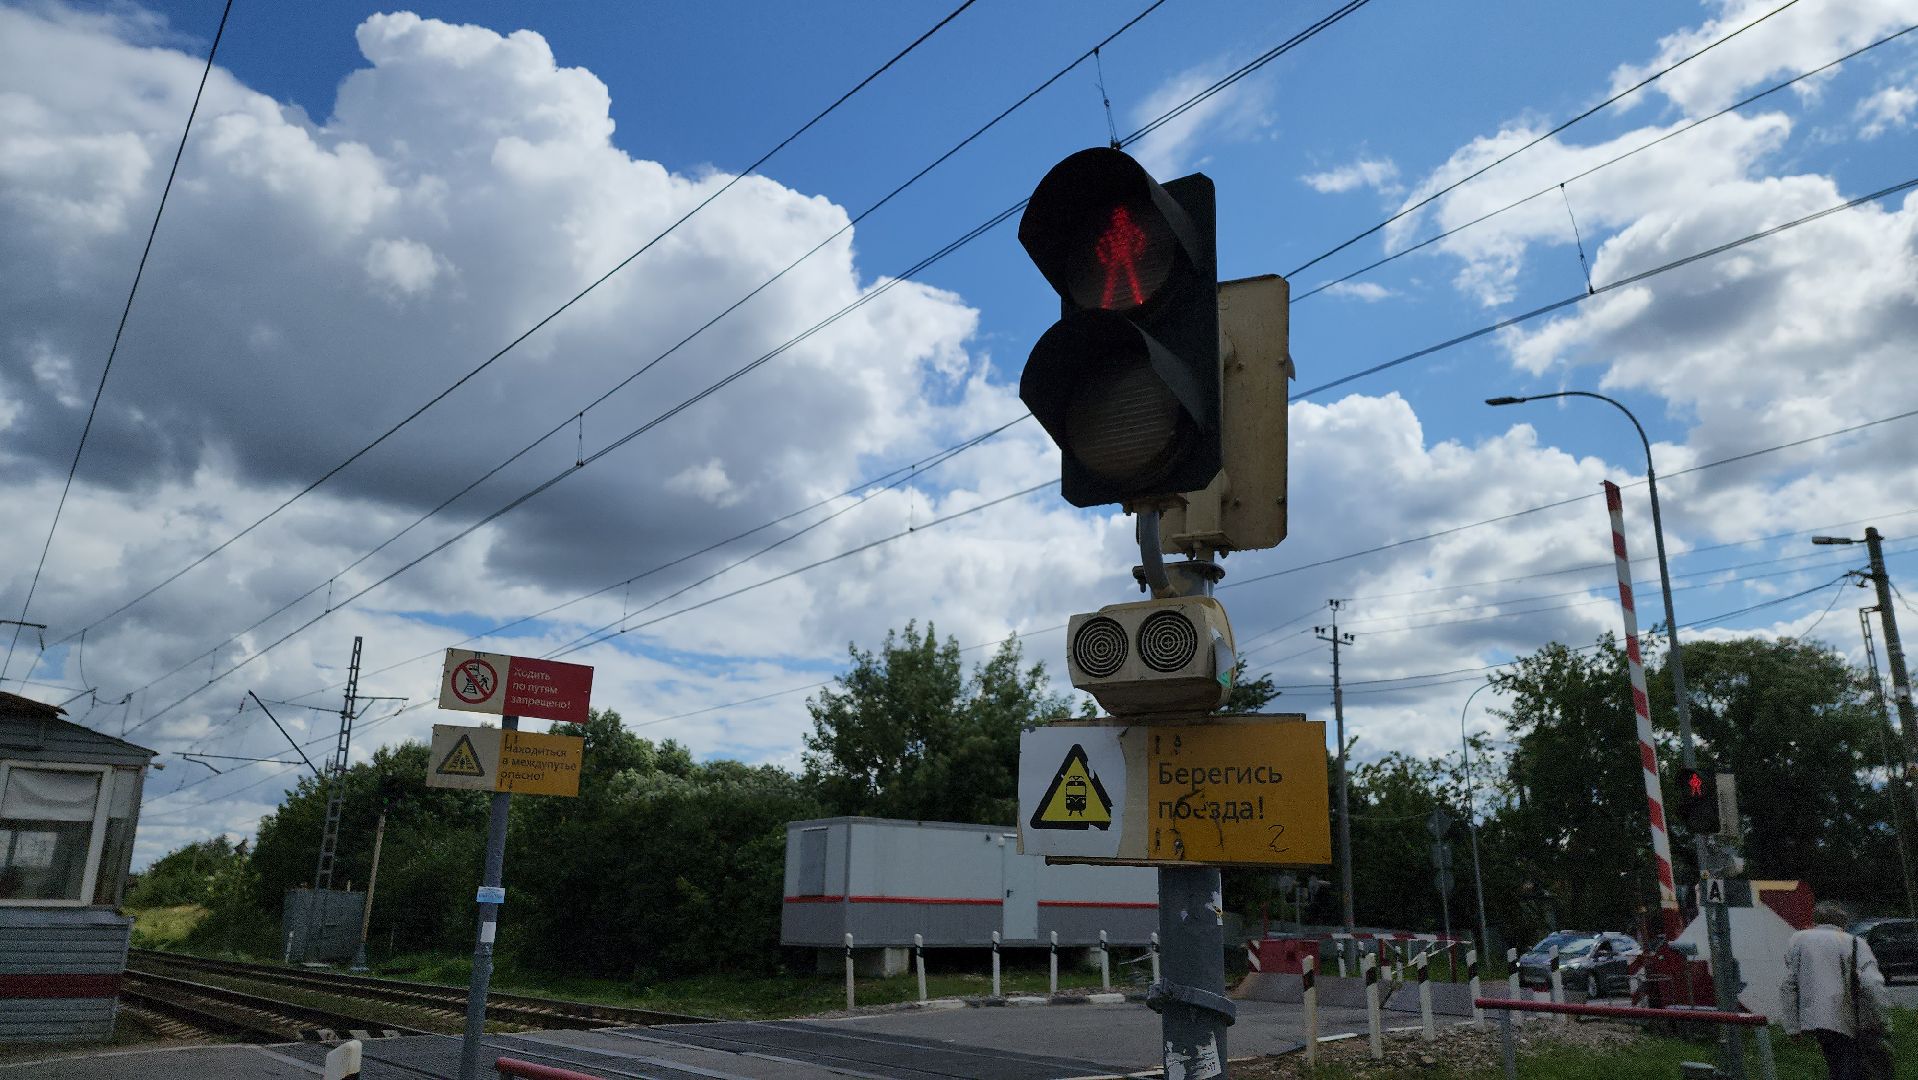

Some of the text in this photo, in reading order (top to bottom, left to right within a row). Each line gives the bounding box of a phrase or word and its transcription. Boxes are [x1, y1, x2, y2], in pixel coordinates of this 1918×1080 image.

[513, 667, 551, 681] Ходить
[512, 682, 559, 695] по путям
[511, 695, 571, 709] запрещено!
[505, 744, 567, 757] Находиться
[511, 758, 577, 772] междупутье
[500, 771, 545, 782] опасно!
[1158, 762, 1283, 792] Берегись
[1158, 796, 1264, 824] поезда!
[1268, 824, 1290, 853] 2
